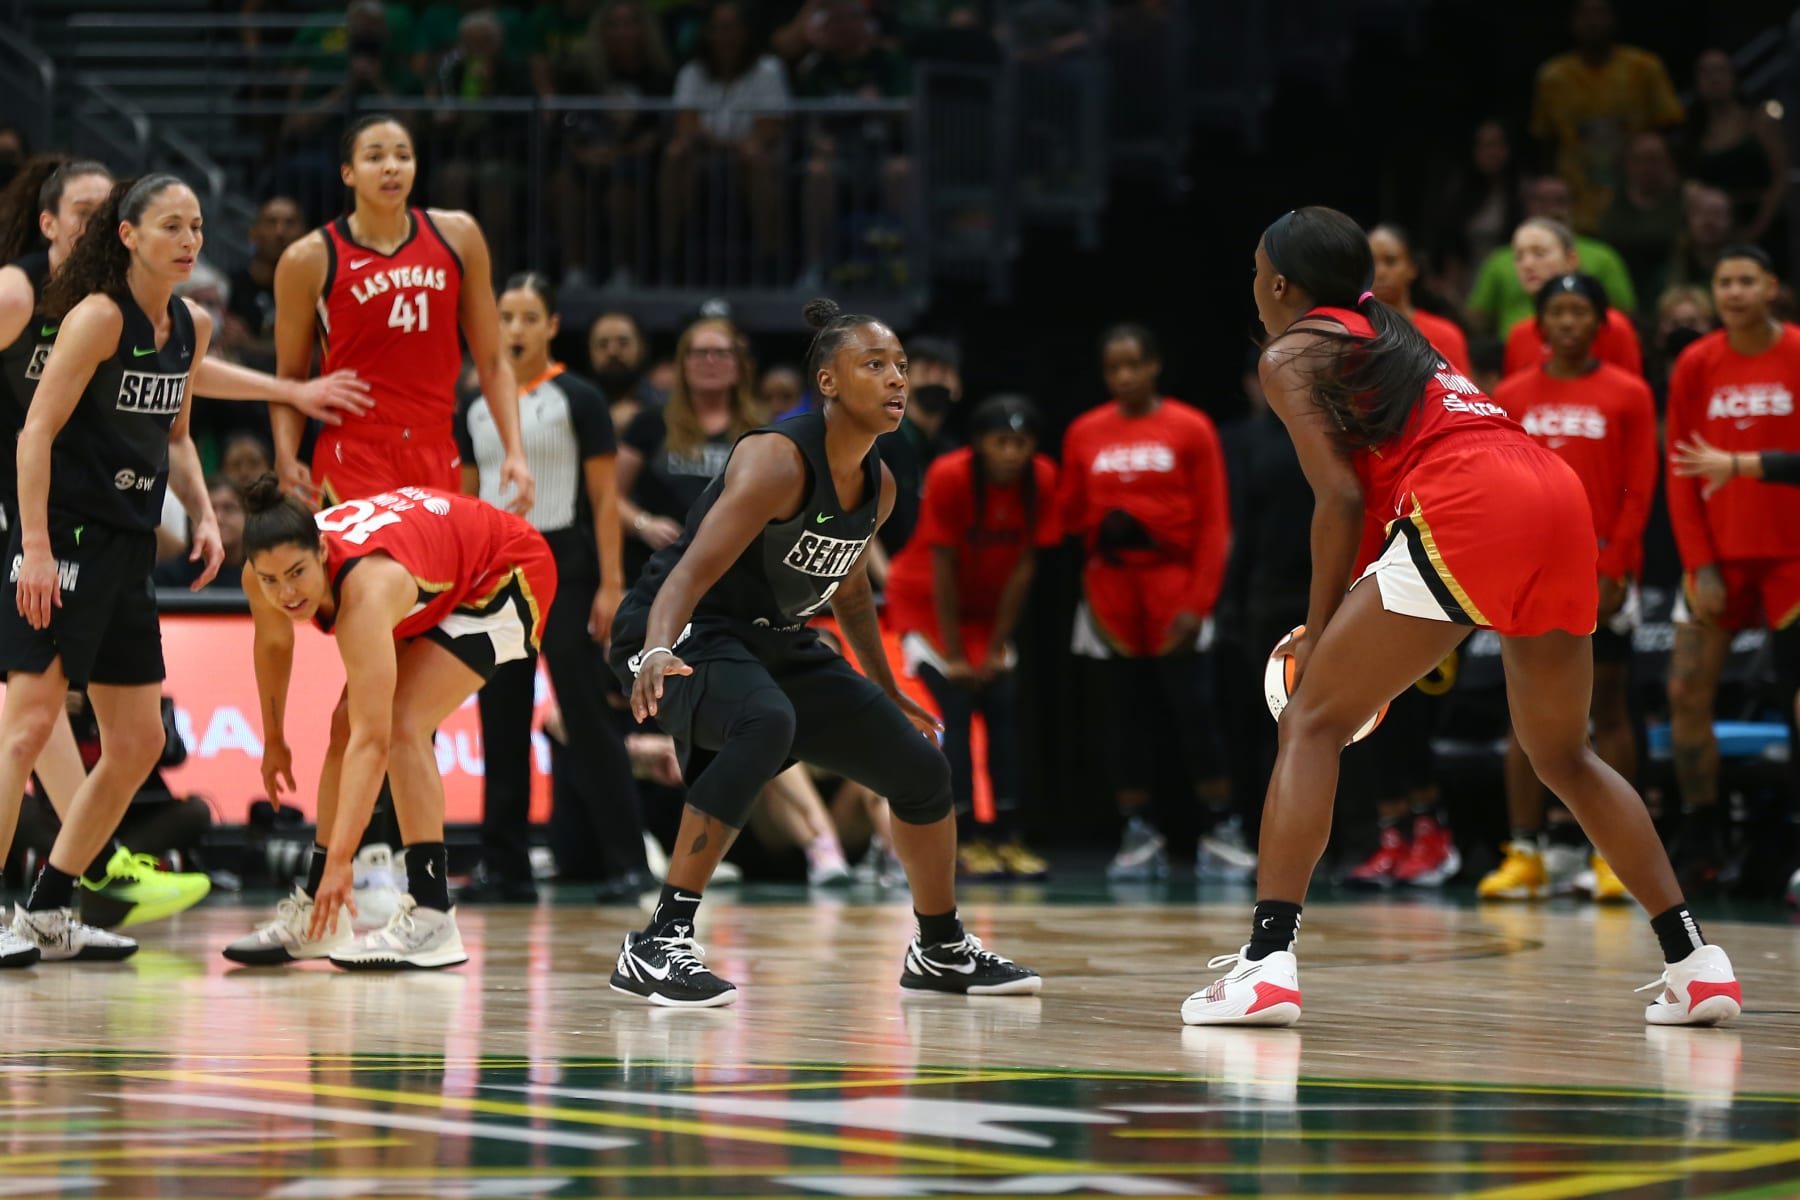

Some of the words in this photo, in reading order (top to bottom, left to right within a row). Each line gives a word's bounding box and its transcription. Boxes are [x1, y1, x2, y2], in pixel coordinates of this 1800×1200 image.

[350, 271, 390, 305] LAS
[388, 264, 446, 291] VEGAS
[388, 290, 429, 333] 41
[118, 375, 188, 410] SEATT
[314, 499, 402, 545] 10
[788, 535, 865, 575] SEATT
